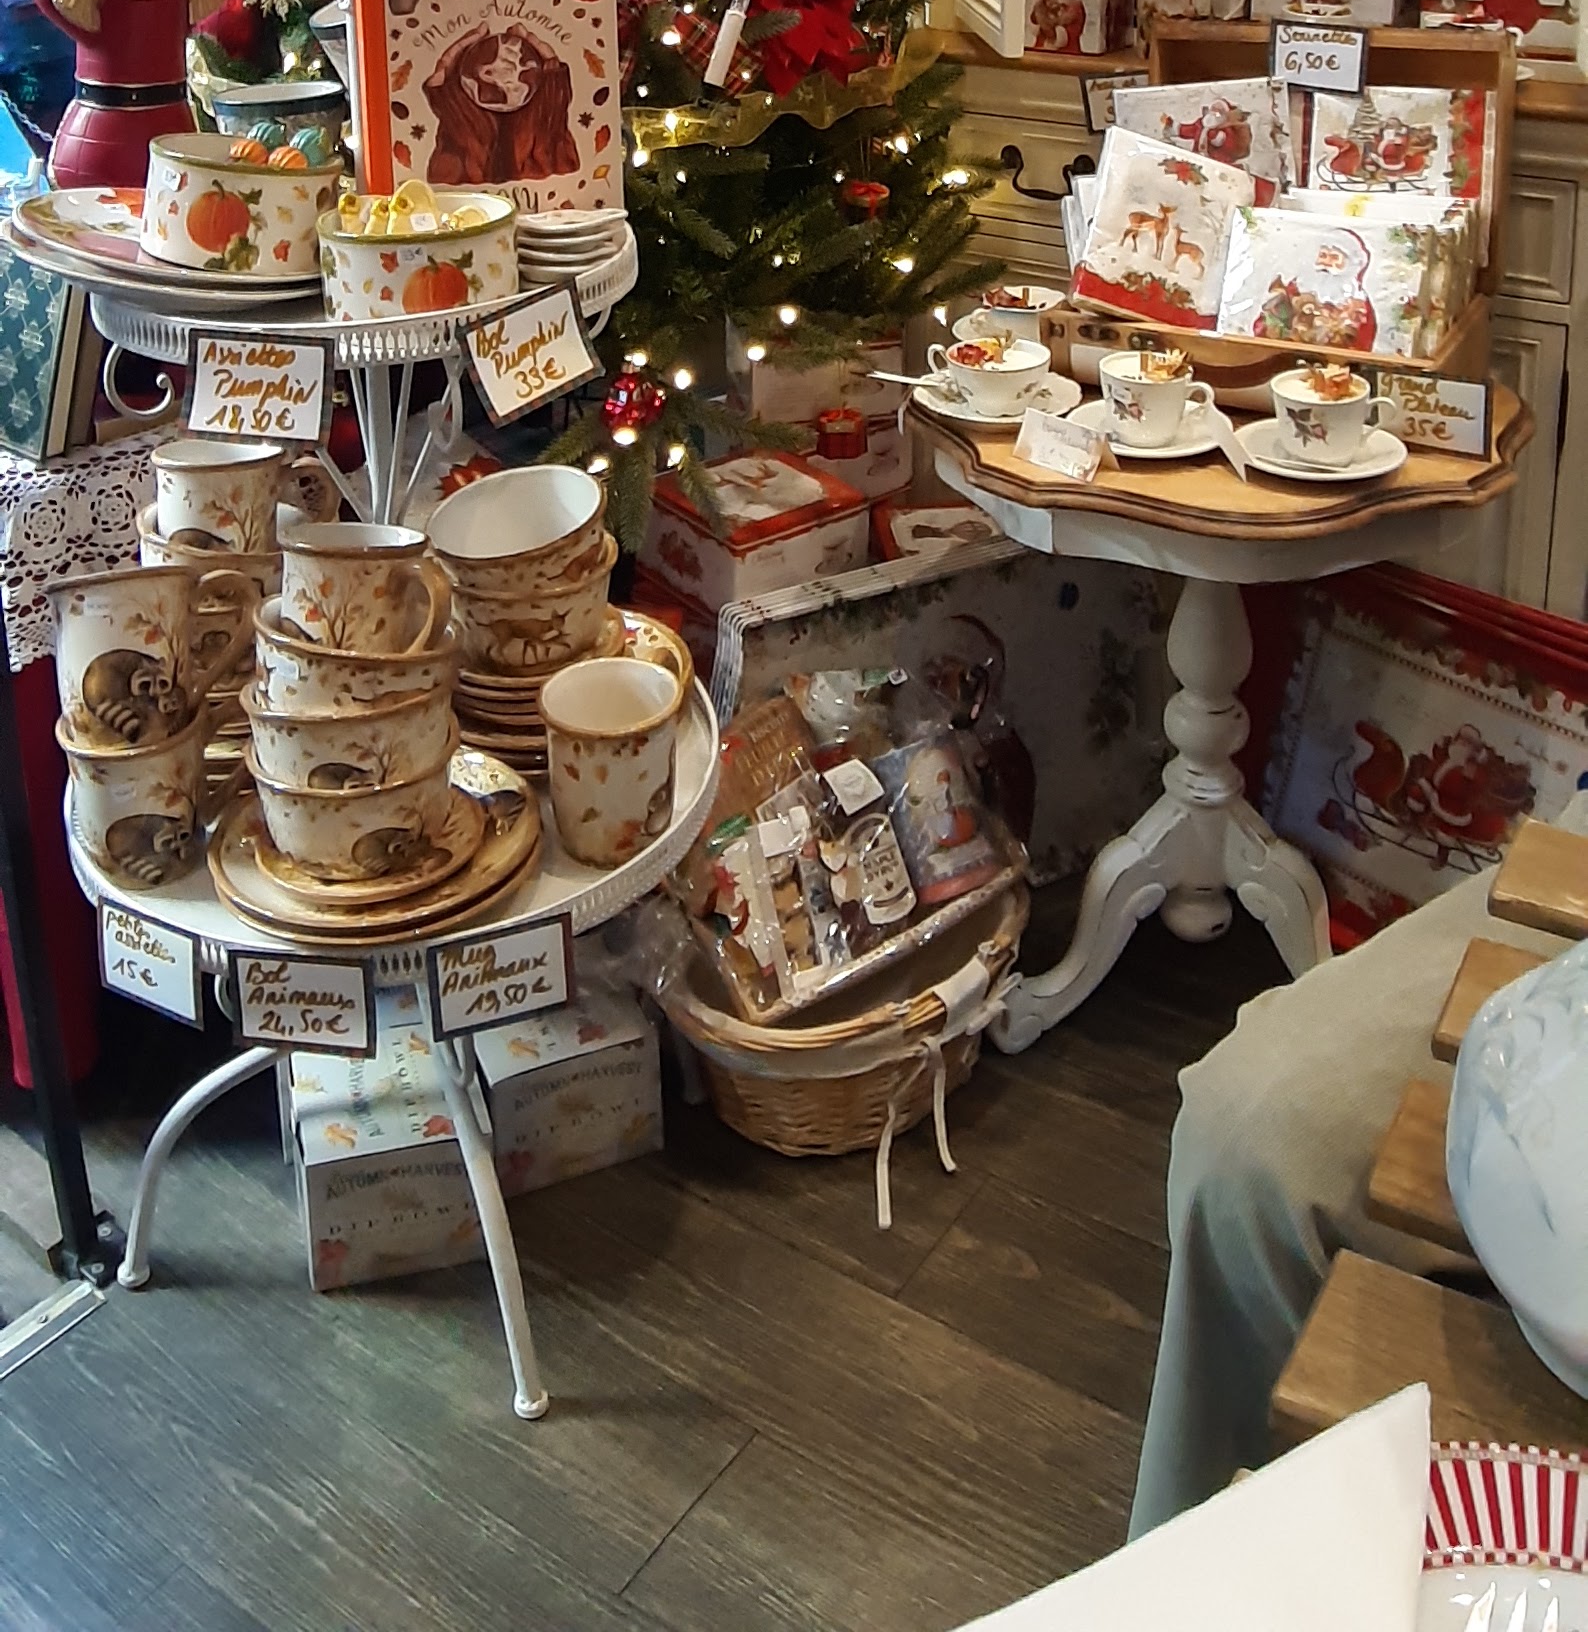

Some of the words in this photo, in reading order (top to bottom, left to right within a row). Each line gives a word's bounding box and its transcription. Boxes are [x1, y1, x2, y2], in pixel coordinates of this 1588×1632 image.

[412, 13, 472, 50] Mon
[1284, 50, 1341, 74] 6,50€
[213, 368, 318, 409] Pumpkin
[1402, 416, 1455, 441] 35€
[245, 960, 292, 985] Bol
[442, 951, 548, 997] Animaux
[246, 986, 356, 1010] Animaux
[258, 1008, 350, 1037] 24,50€
